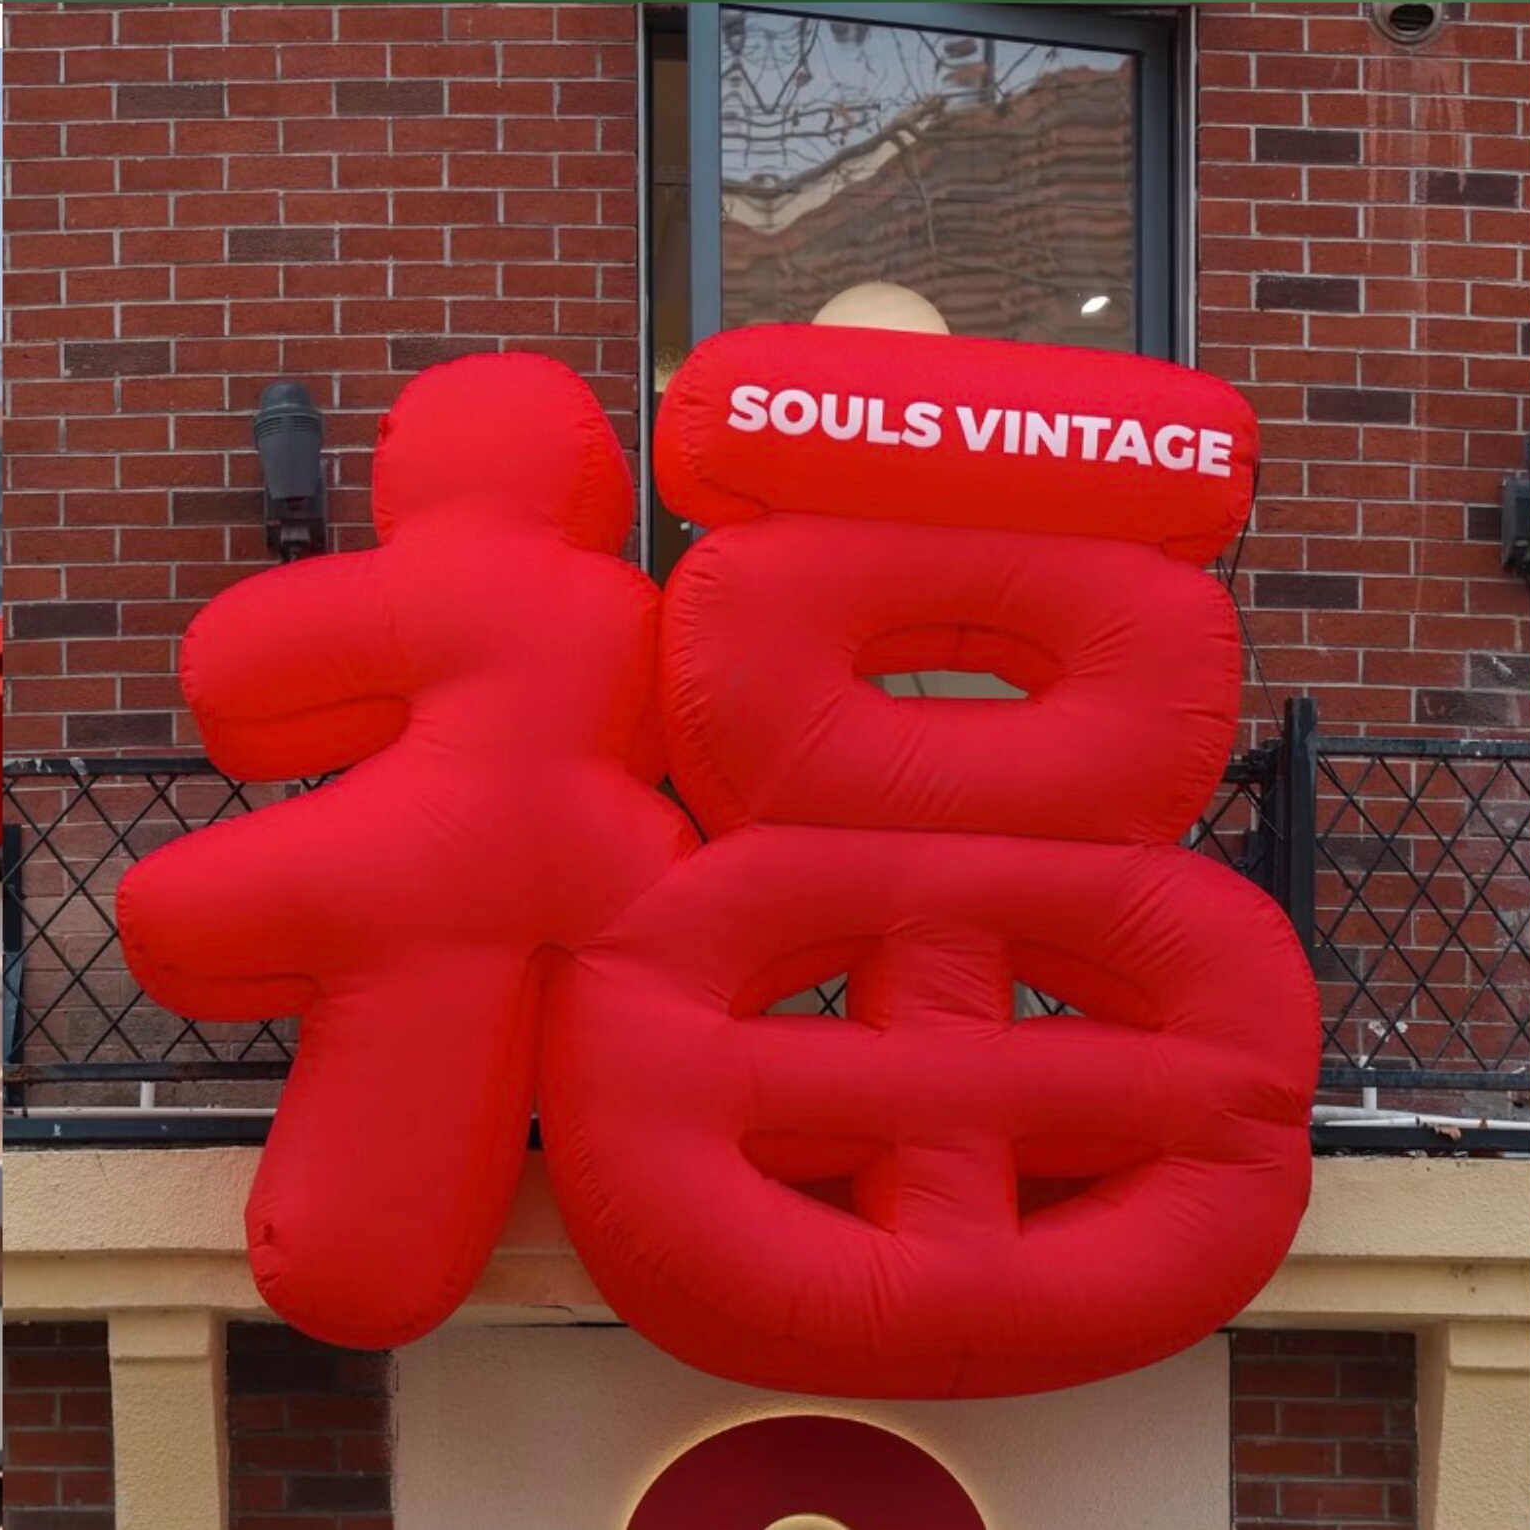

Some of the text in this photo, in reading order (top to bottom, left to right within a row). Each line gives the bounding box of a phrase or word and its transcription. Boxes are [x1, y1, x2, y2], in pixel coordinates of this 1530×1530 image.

[727, 384, 1235, 478] SOULS VINTAGE
[117, 322, 1321, 1400] 福
